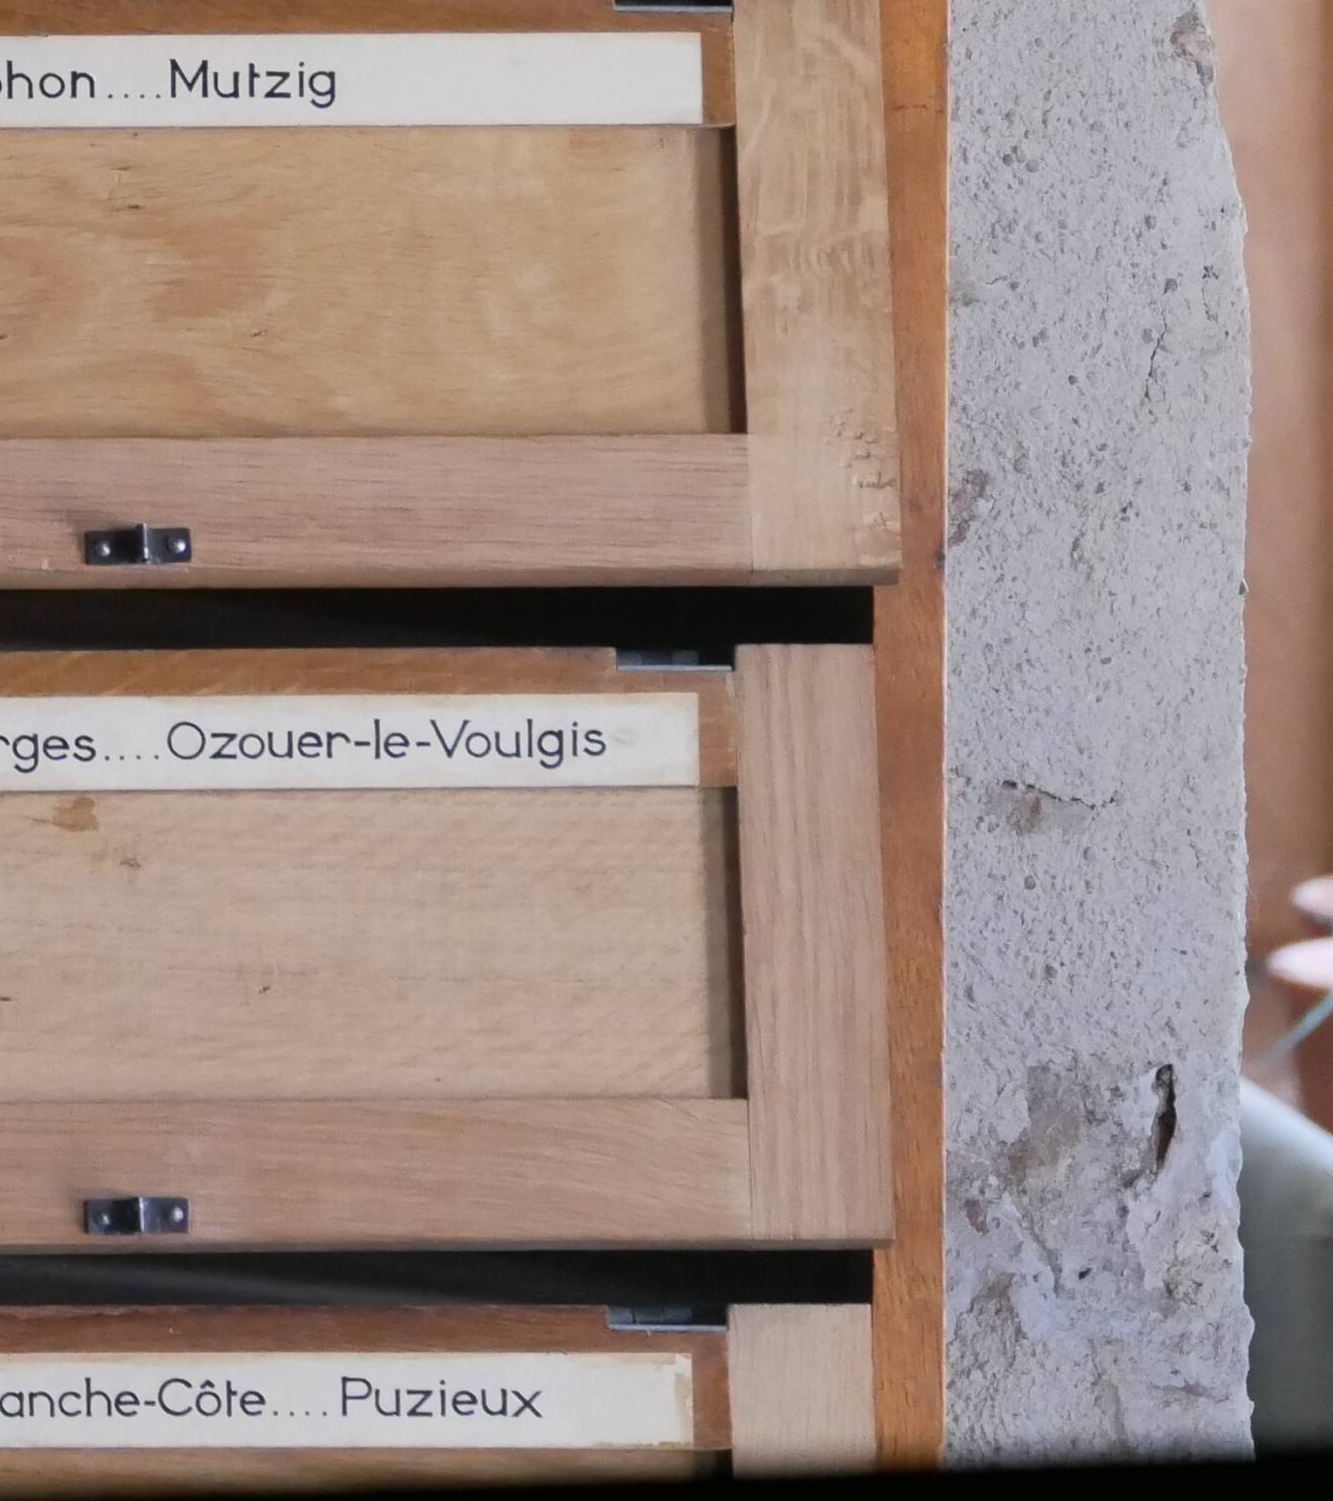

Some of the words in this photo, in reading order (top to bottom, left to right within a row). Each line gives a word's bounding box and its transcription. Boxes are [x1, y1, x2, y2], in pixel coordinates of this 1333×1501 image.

[169, 58, 336, 110] Mutzig
[167, 717, 607, 769] Ozouer-le-Voulgis
[340, 1376, 543, 1418] Puzieux
